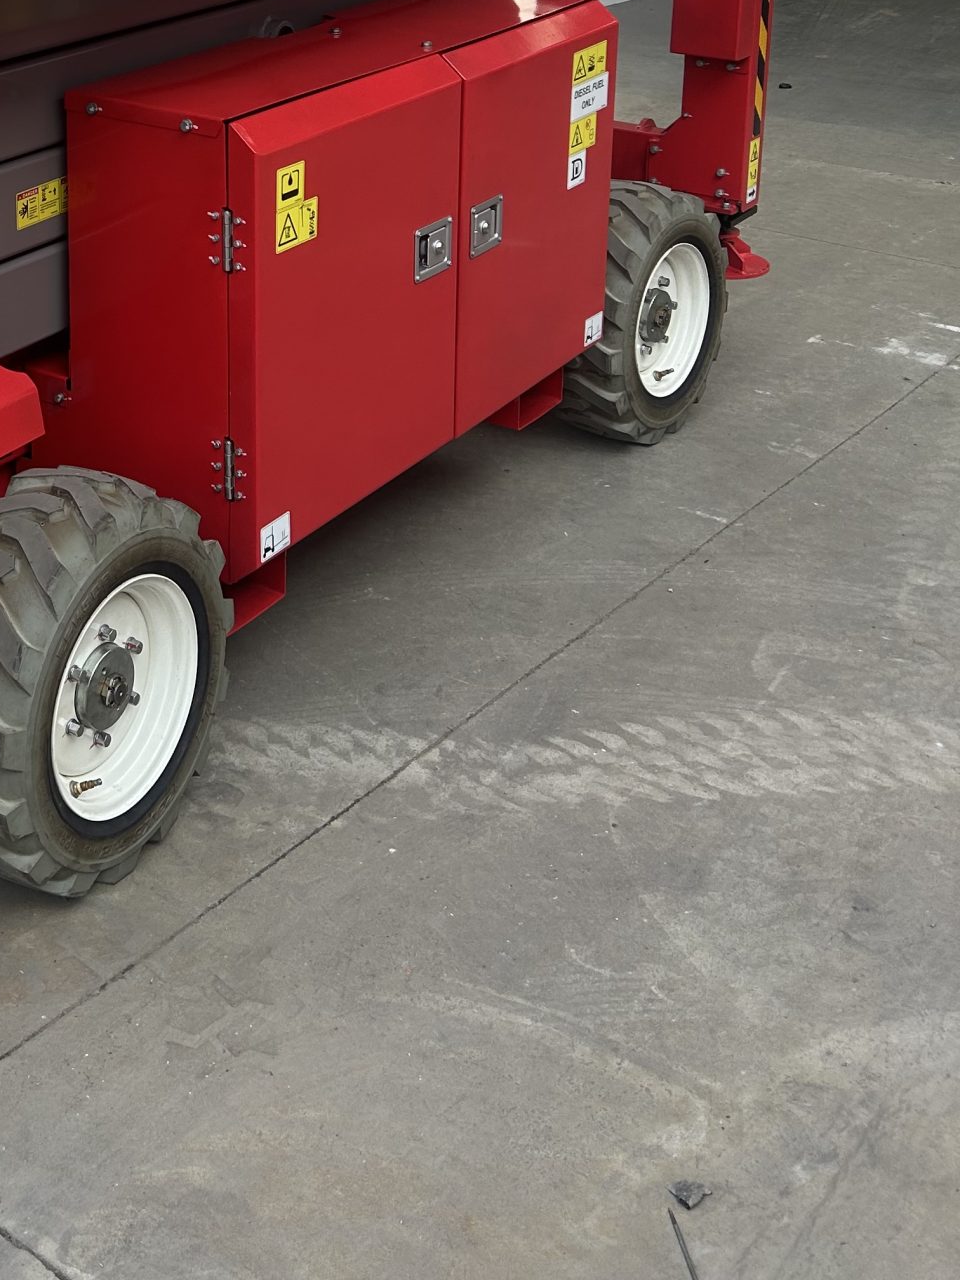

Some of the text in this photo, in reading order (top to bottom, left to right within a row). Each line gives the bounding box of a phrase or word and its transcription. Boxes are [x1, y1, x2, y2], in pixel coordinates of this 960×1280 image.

[574, 79, 605, 99] DIESEL FUEL
[581, 96, 596, 109] ONLY
